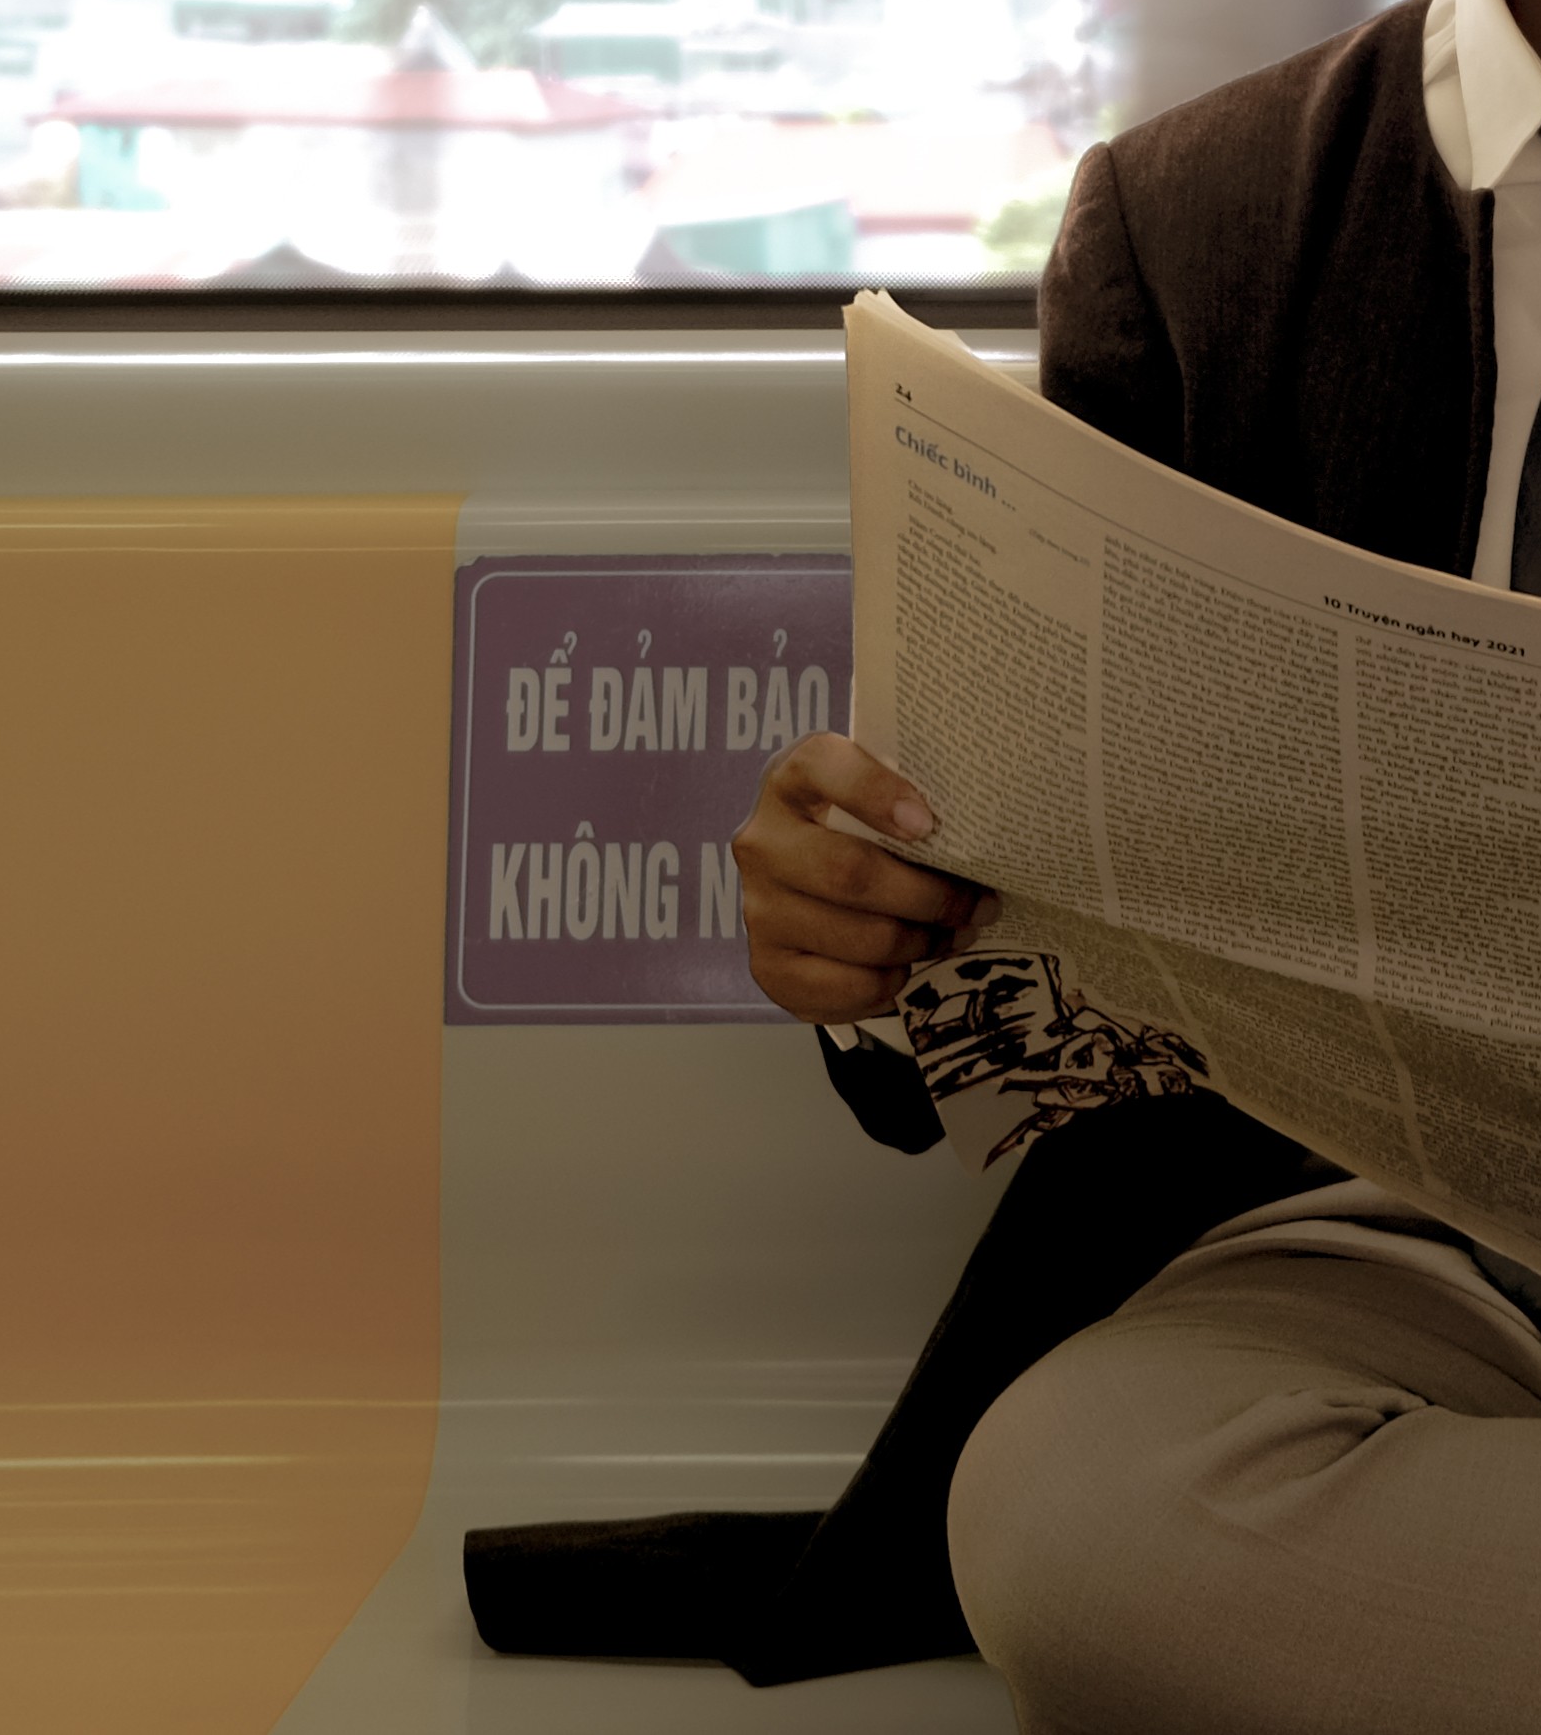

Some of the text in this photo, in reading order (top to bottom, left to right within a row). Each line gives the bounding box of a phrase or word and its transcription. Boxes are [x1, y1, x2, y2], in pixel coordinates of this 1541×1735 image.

[895, 425, 948, 470] Chiếc
[954, 458, 997, 499] bình
[1323, 596, 1342, 610] 10
[1346, 603, 1401, 628] Truyện
[1451, 631, 1480, 648] hay
[1487, 639, 1526, 657] 2021
[506, 631, 578, 751] ĐỂ
[589, 629, 708, 751] ĐẢM
[489, 821, 747, 940] KHÔNG N
